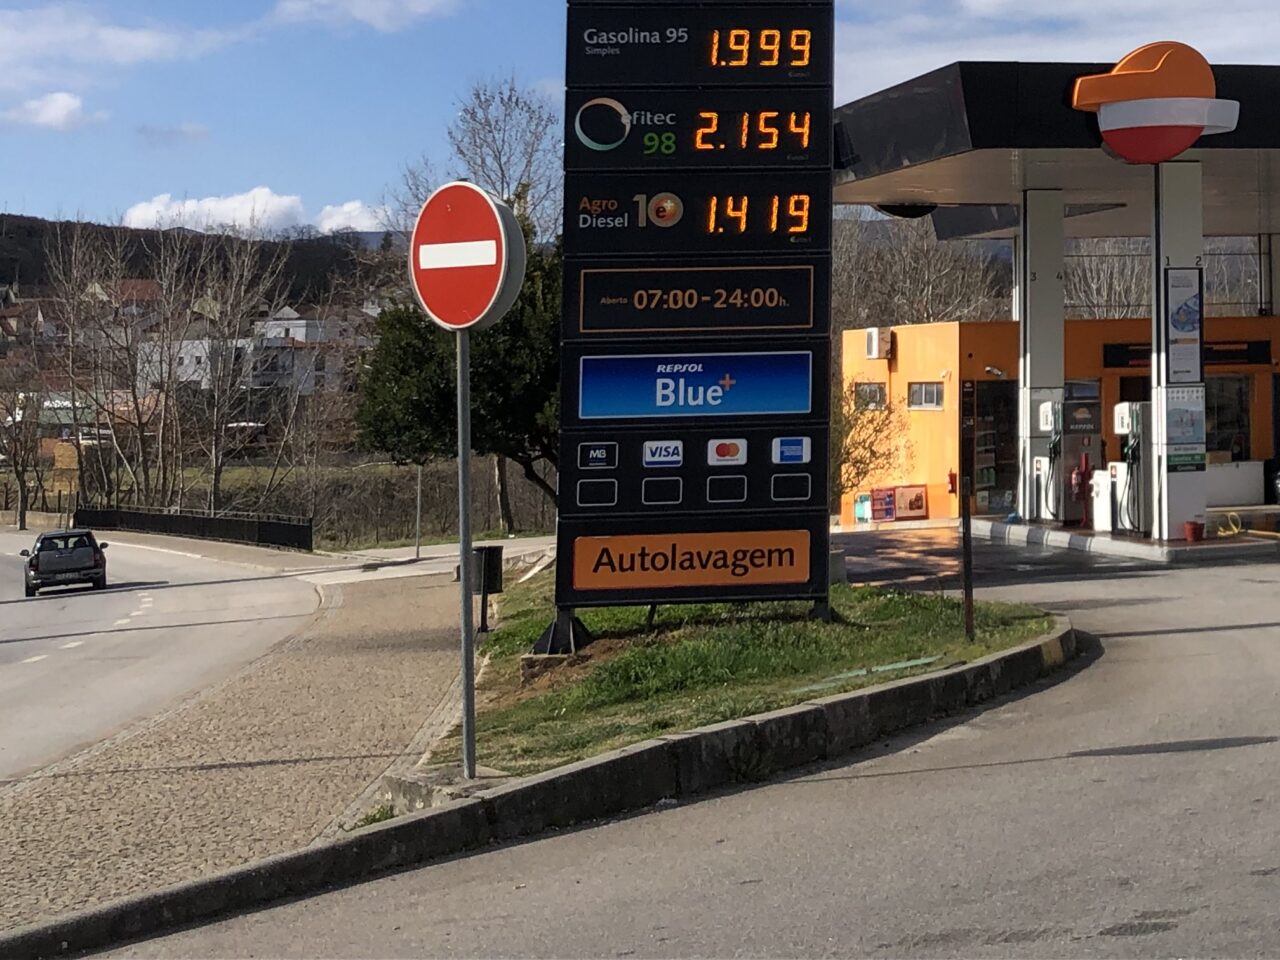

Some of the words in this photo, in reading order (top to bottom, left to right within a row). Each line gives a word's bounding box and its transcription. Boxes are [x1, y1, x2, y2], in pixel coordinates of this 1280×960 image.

[583, 28, 660, 45] Gasolina
[666, 27, 688, 44] 95
[710, 28, 812, 66] 1.999
[585, 46, 621, 57] Simples
[695, 111, 811, 149] 2.154
[643, 132, 677, 155] 98
[578, 196, 618, 214] Agro
[708, 193, 811, 234] 1.419
[578, 213, 629, 229] Diesel
[1165, 256, 1171, 266] 1
[1195, 256, 1202, 266] 2
[1030, 272, 1037, 282] 3
[656, 363, 704, 373] REPSOL
[648, 445, 680, 458] VISA
[592, 543, 795, 576] Autolavagem
